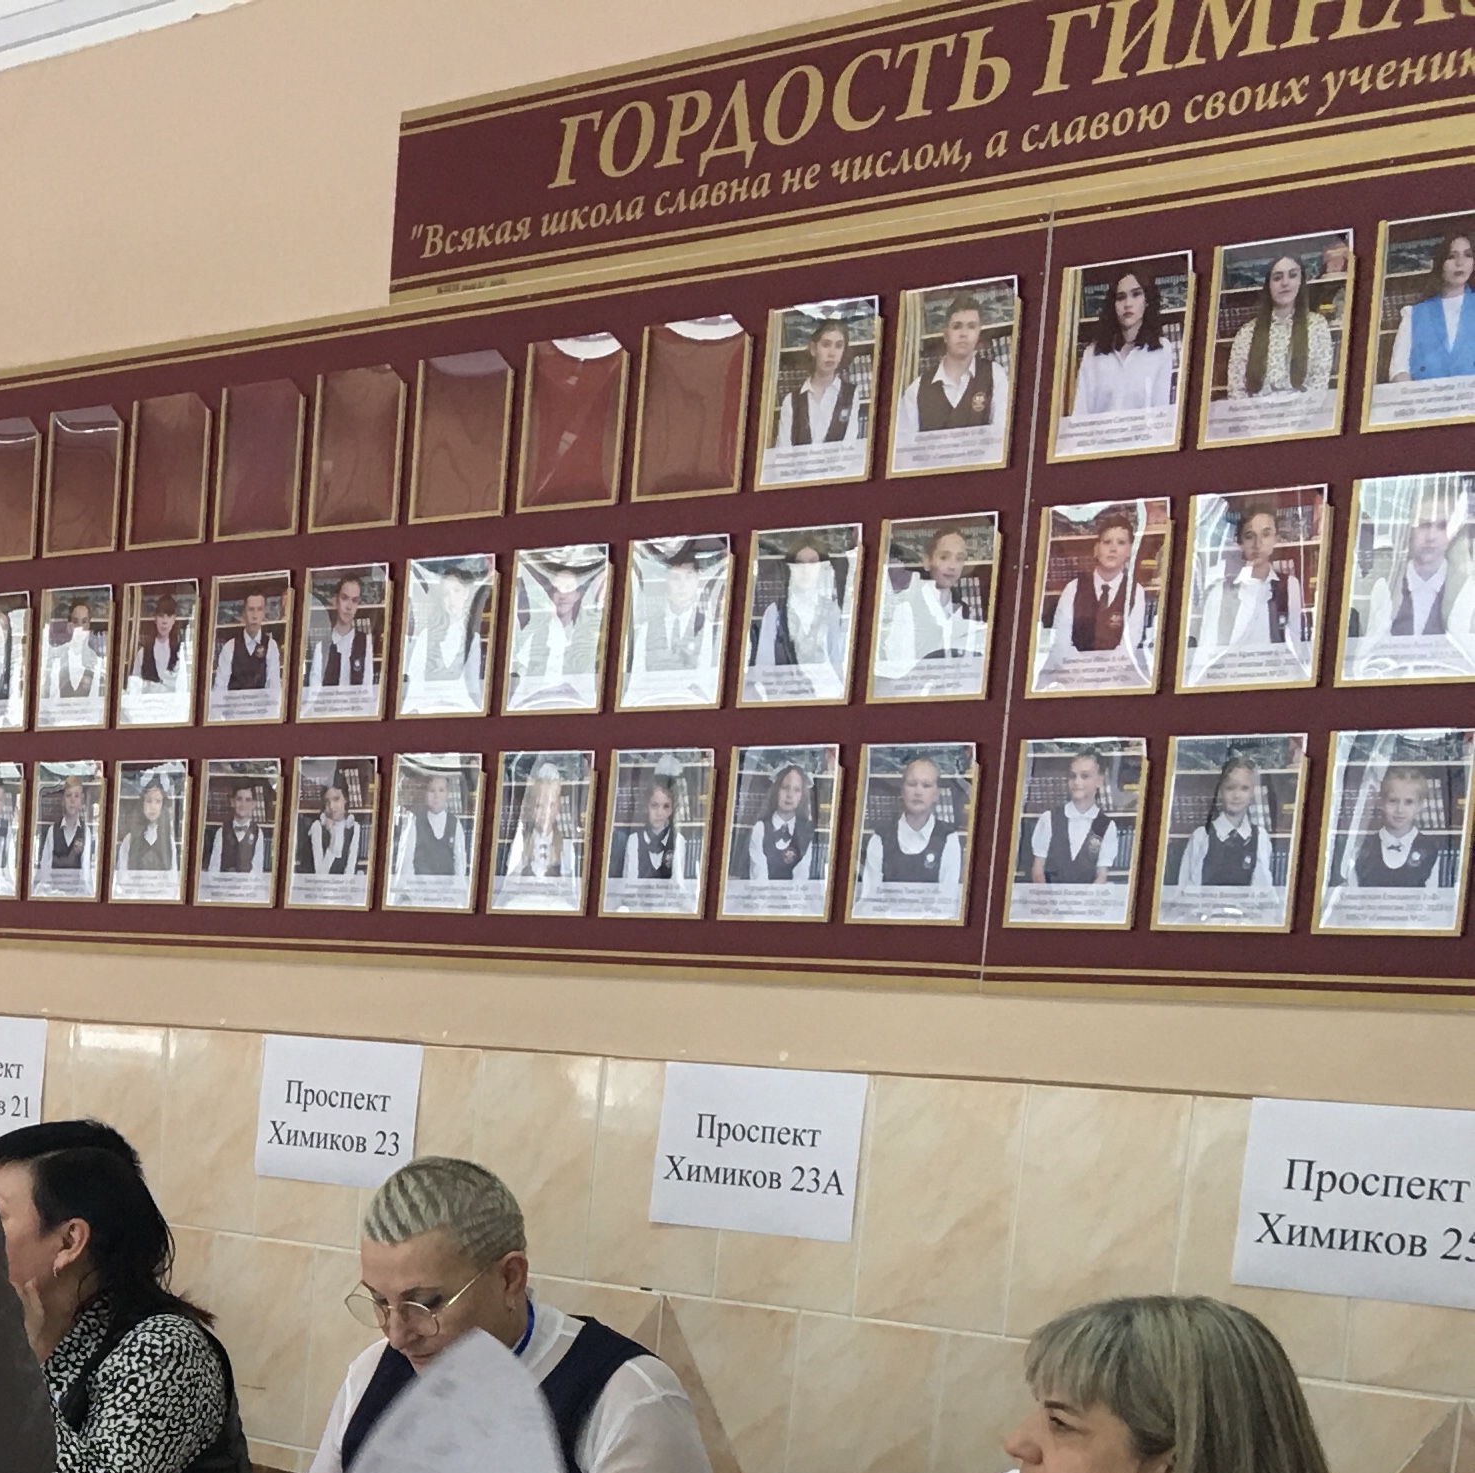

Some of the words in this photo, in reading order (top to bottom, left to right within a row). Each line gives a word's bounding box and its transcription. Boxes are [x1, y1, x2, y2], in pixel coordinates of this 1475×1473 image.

[547, 26, 1012, 189] ГОРДОСТЬ
[410, 214, 531, 259] "Всякая
[541, 195, 644, 237] школа
[654, 170, 770, 217] славна
[781, 161, 821, 195] не
[831, 138, 972, 185] числом,
[985, 130, 1009, 159] а
[1021, 99, 1171, 153] славою
[1183, 75, 1311, 121] своих
[11, 1095, 29, 1118] 21
[285, 1079, 391, 1113] Проспект
[267, 1120, 367, 1153] Химиков
[373, 1130, 400, 1157] 23
[696, 1113, 822, 1147] Проспект
[663, 1155, 782, 1190] Химиков
[790, 1165, 844, 1196] 23А
[1283, 1158, 1471, 1203] Проспект
[1254, 1212, 1427, 1258] Химиков
